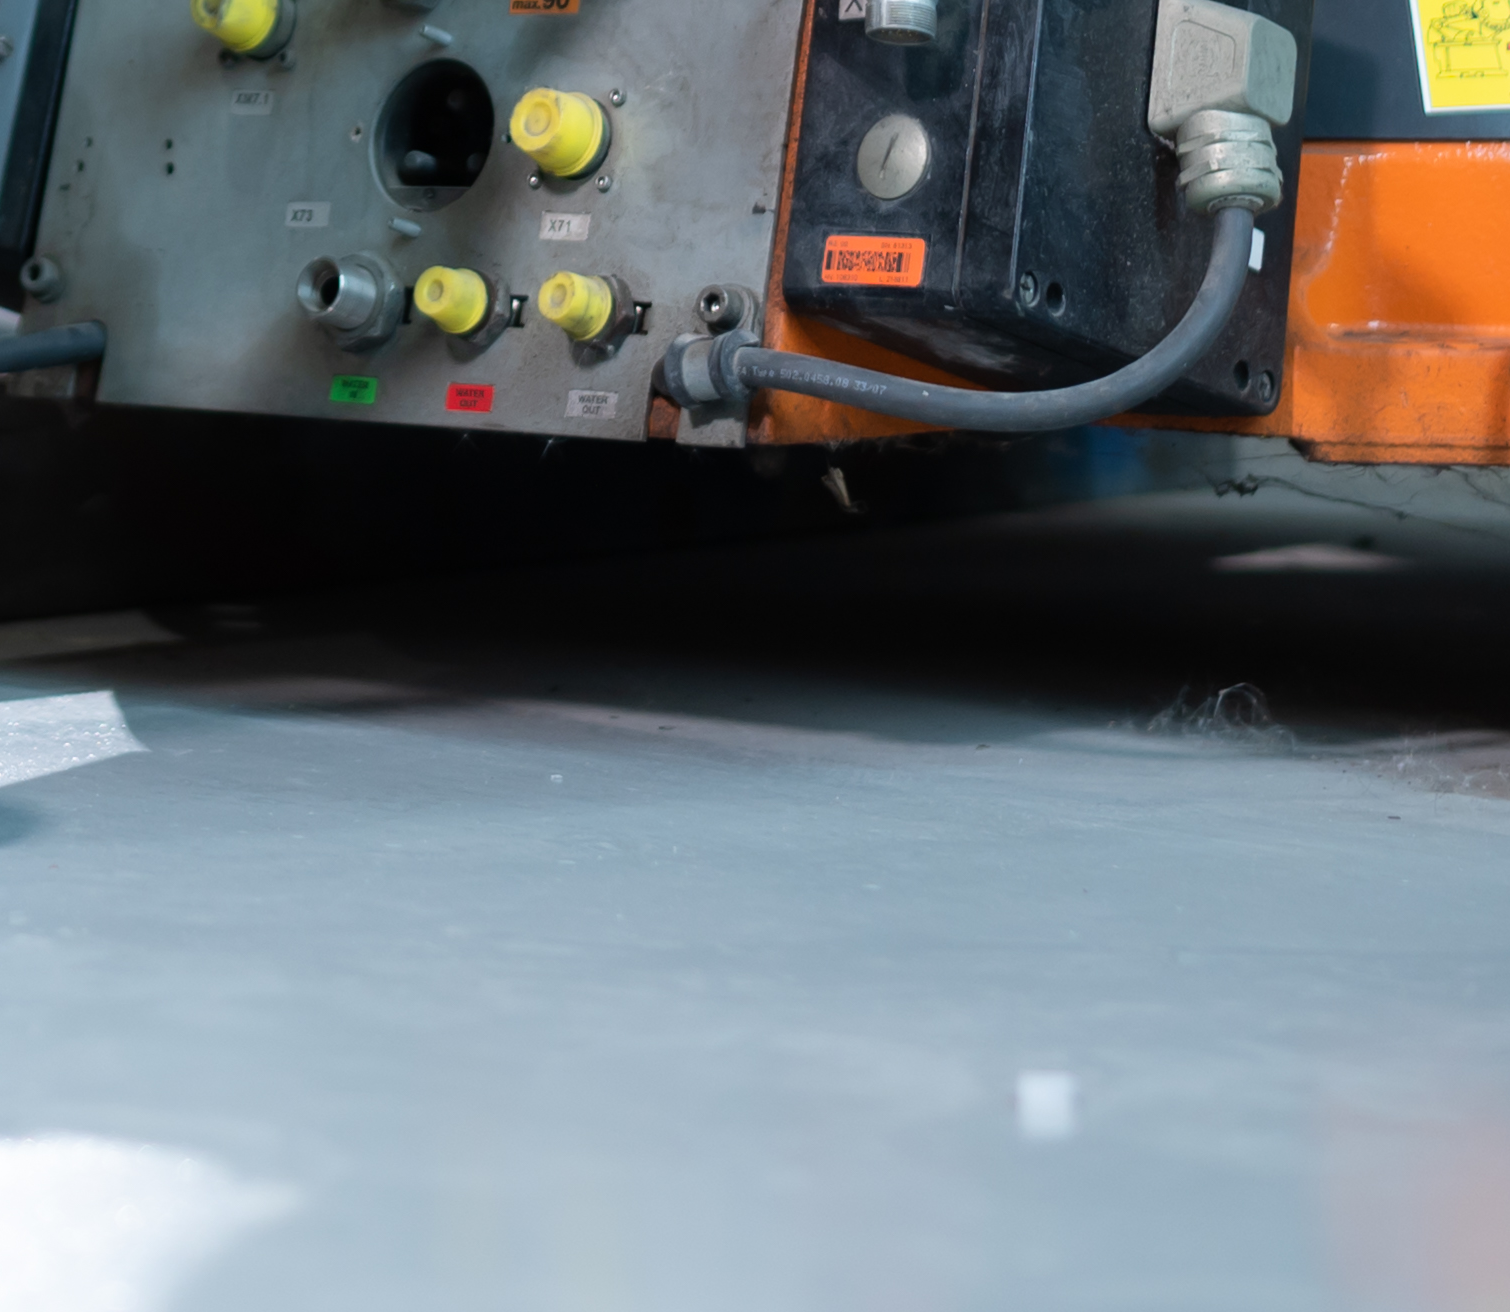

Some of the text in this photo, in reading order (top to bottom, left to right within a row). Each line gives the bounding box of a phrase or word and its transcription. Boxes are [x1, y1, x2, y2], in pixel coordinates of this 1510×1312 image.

[511, 0, 541, 10] max.
[548, 219, 571, 233] X71
[456, 388, 485, 398] WATER
[459, 399, 478, 408] OUT
[579, 394, 609, 405] WATER
[582, 405, 601, 416] OUT
